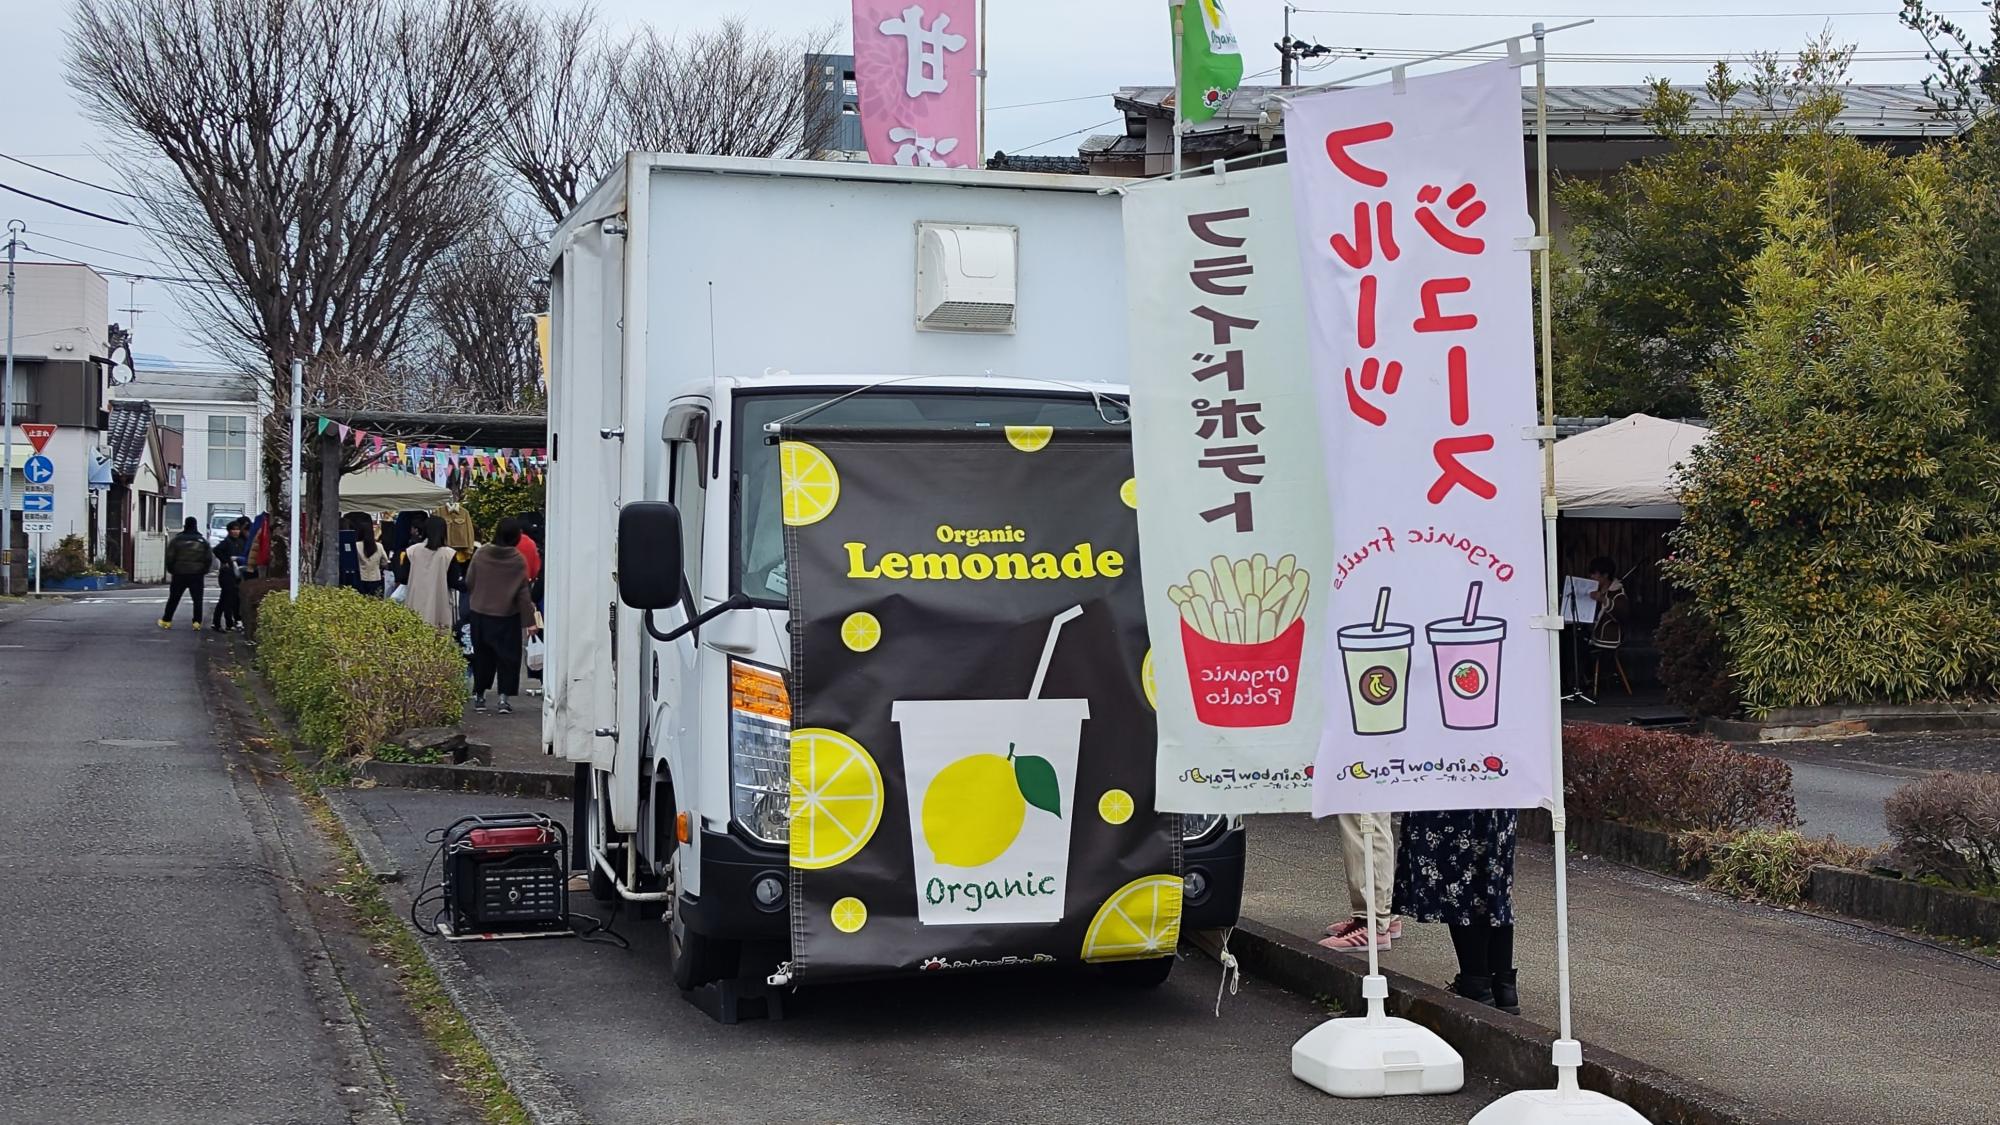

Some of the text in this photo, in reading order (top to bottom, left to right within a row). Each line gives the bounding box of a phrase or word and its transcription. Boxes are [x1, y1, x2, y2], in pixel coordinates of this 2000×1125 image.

[936, 525, 1026, 547] Organic
[843, 542, 1124, 580] Lemonade
[926, 872, 1056, 912] Organic
